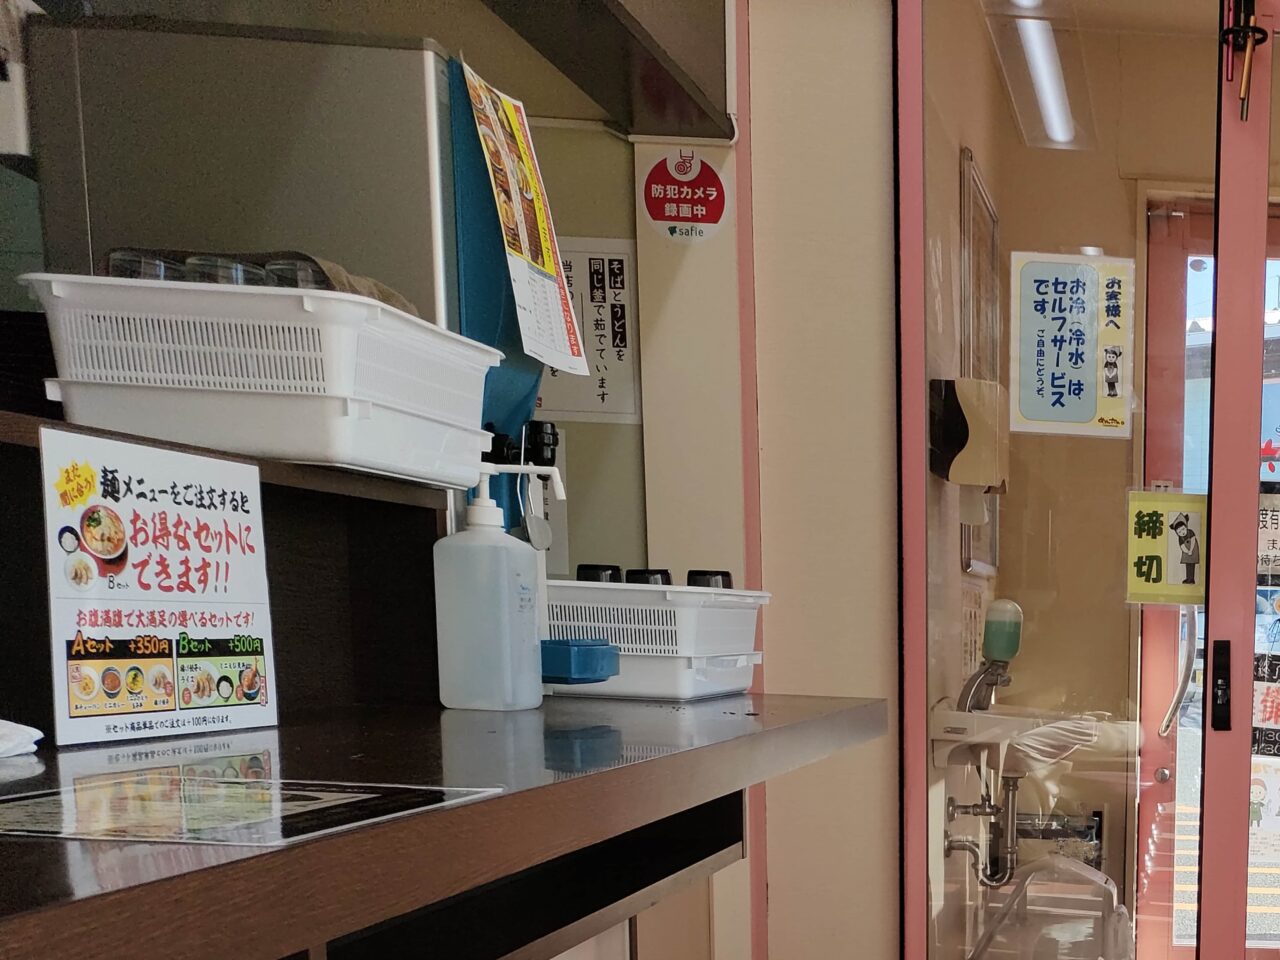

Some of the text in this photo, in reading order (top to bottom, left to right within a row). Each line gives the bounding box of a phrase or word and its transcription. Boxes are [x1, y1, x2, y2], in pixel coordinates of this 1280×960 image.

[651, 184, 718, 199] 防犯カメラ
[664, 203, 706, 218] 録画中
[679, 226, 704, 238] safie
[609, 260, 627, 362] そばとうどんを
[1105, 276, 1122, 330] お客様へ
[590, 260, 609, 403] 同じ釜で茹でています
[1033, 279, 1050, 399] です。 ご自由にどうぞ。
[1050, 276, 1069, 409] セルフサービス
[101, 466, 250, 514] 麺メニューをご注文すると
[129, 508, 255, 555] お得なセットに
[1133, 510, 1164, 584] 締切
[131, 553, 230, 594] できます!!
[72, 630, 169, 656] Aセット +350円
[178, 631, 261, 654] Bセット +500円
